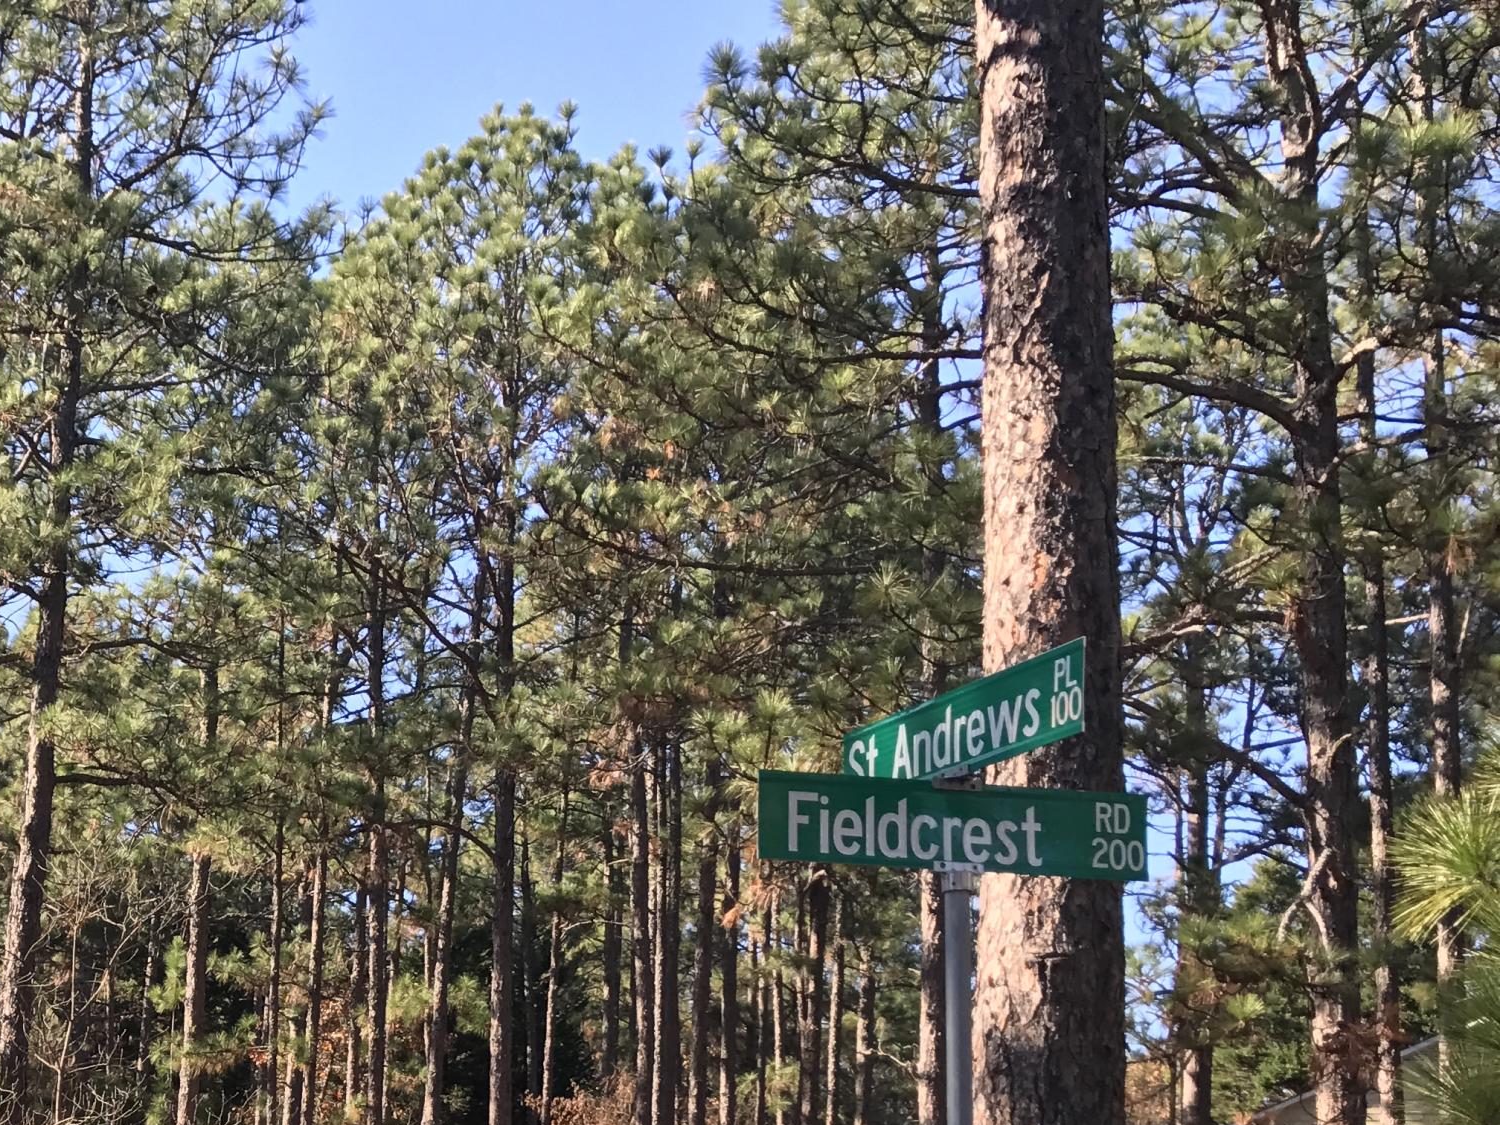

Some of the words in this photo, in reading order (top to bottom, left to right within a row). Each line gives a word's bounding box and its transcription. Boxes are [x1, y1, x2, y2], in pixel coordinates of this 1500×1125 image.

[1054, 656, 1077, 692] PL
[1051, 686, 1082, 728] 100
[849, 739, 878, 777] St
[892, 687, 1041, 779] Andrews
[788, 791, 1043, 867] Fieldcrest
[1095, 802, 1131, 835] RD
[1092, 838, 1144, 872] 200
